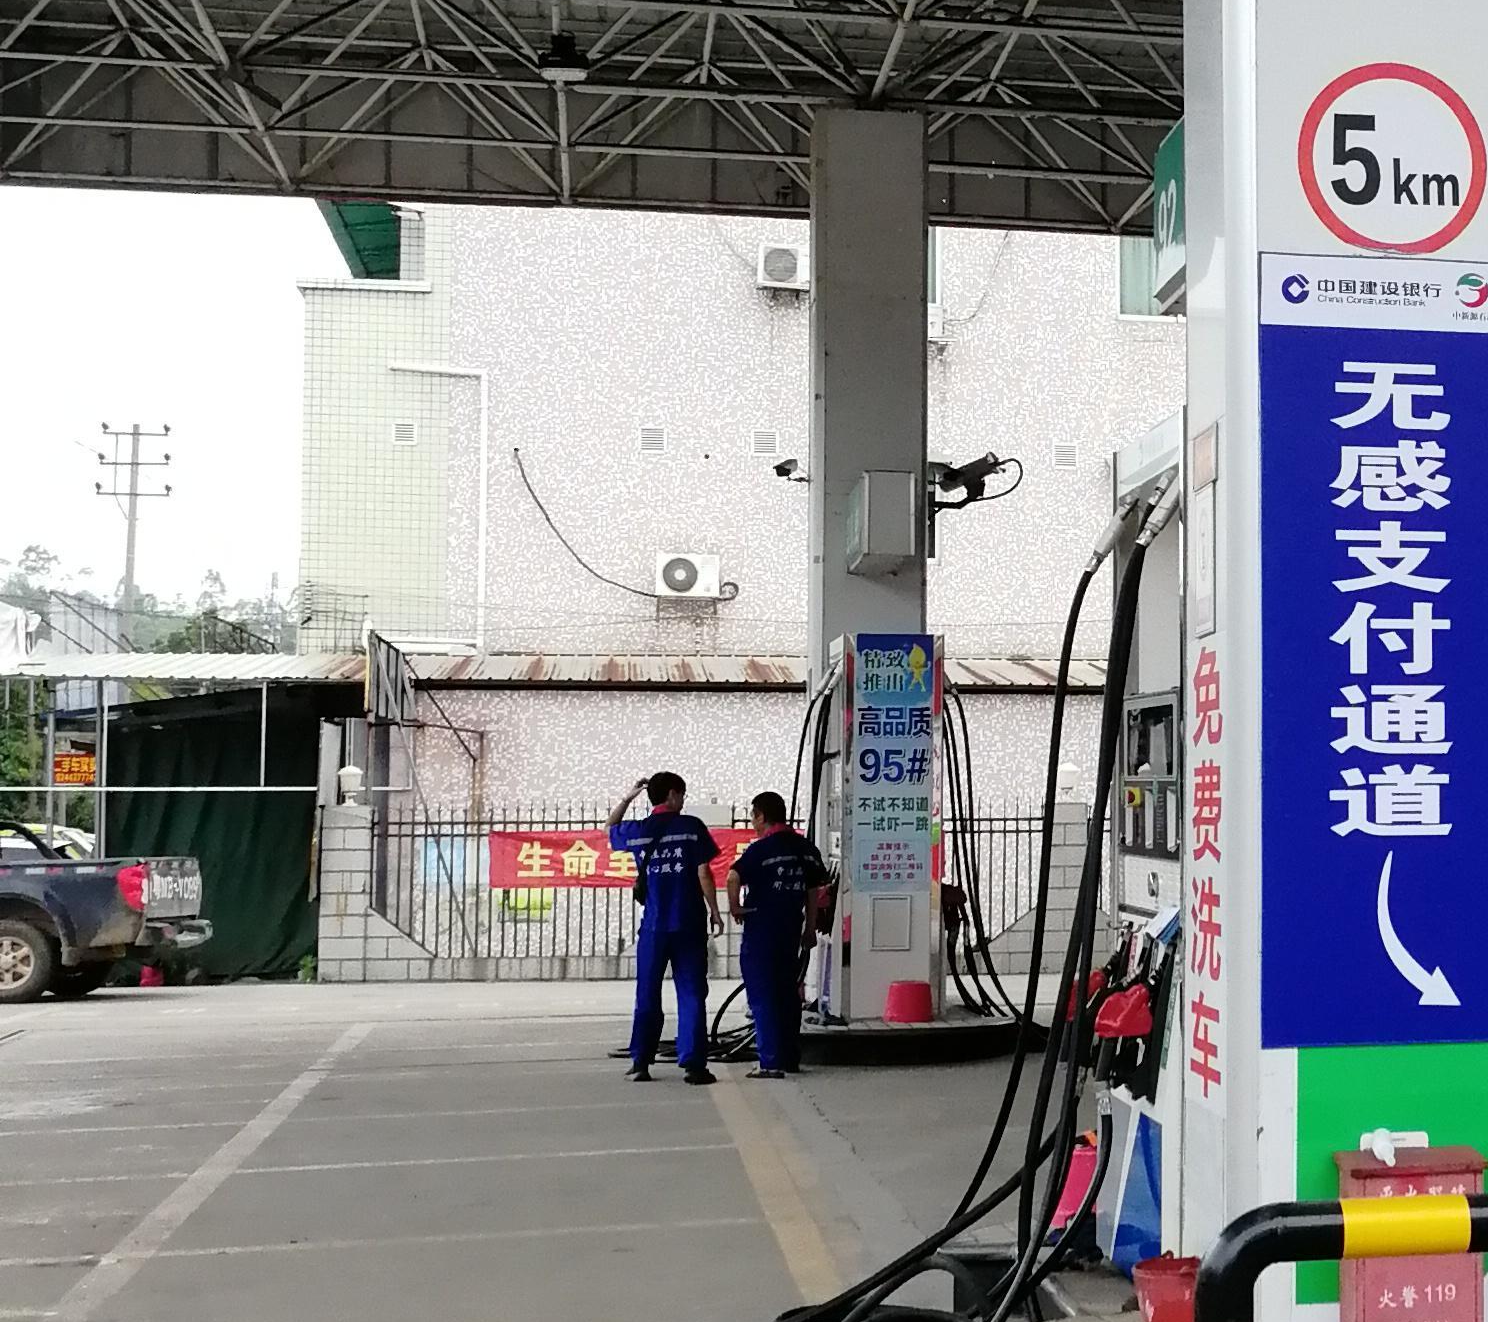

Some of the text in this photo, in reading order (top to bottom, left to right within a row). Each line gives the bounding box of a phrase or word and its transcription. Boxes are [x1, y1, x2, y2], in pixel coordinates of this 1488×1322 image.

[1317, 279, 1442, 298] 中国建设银行
[1329, 360, 1454, 837] 无感支付通道
[857, 705, 932, 737] 高品质
[859, 748, 930, 784] 95#
[858, 797, 930, 812] 不试不知道
[857, 817, 930, 832] 一试吓一跳
[1190, 647, 1224, 1100] 免费洗车
